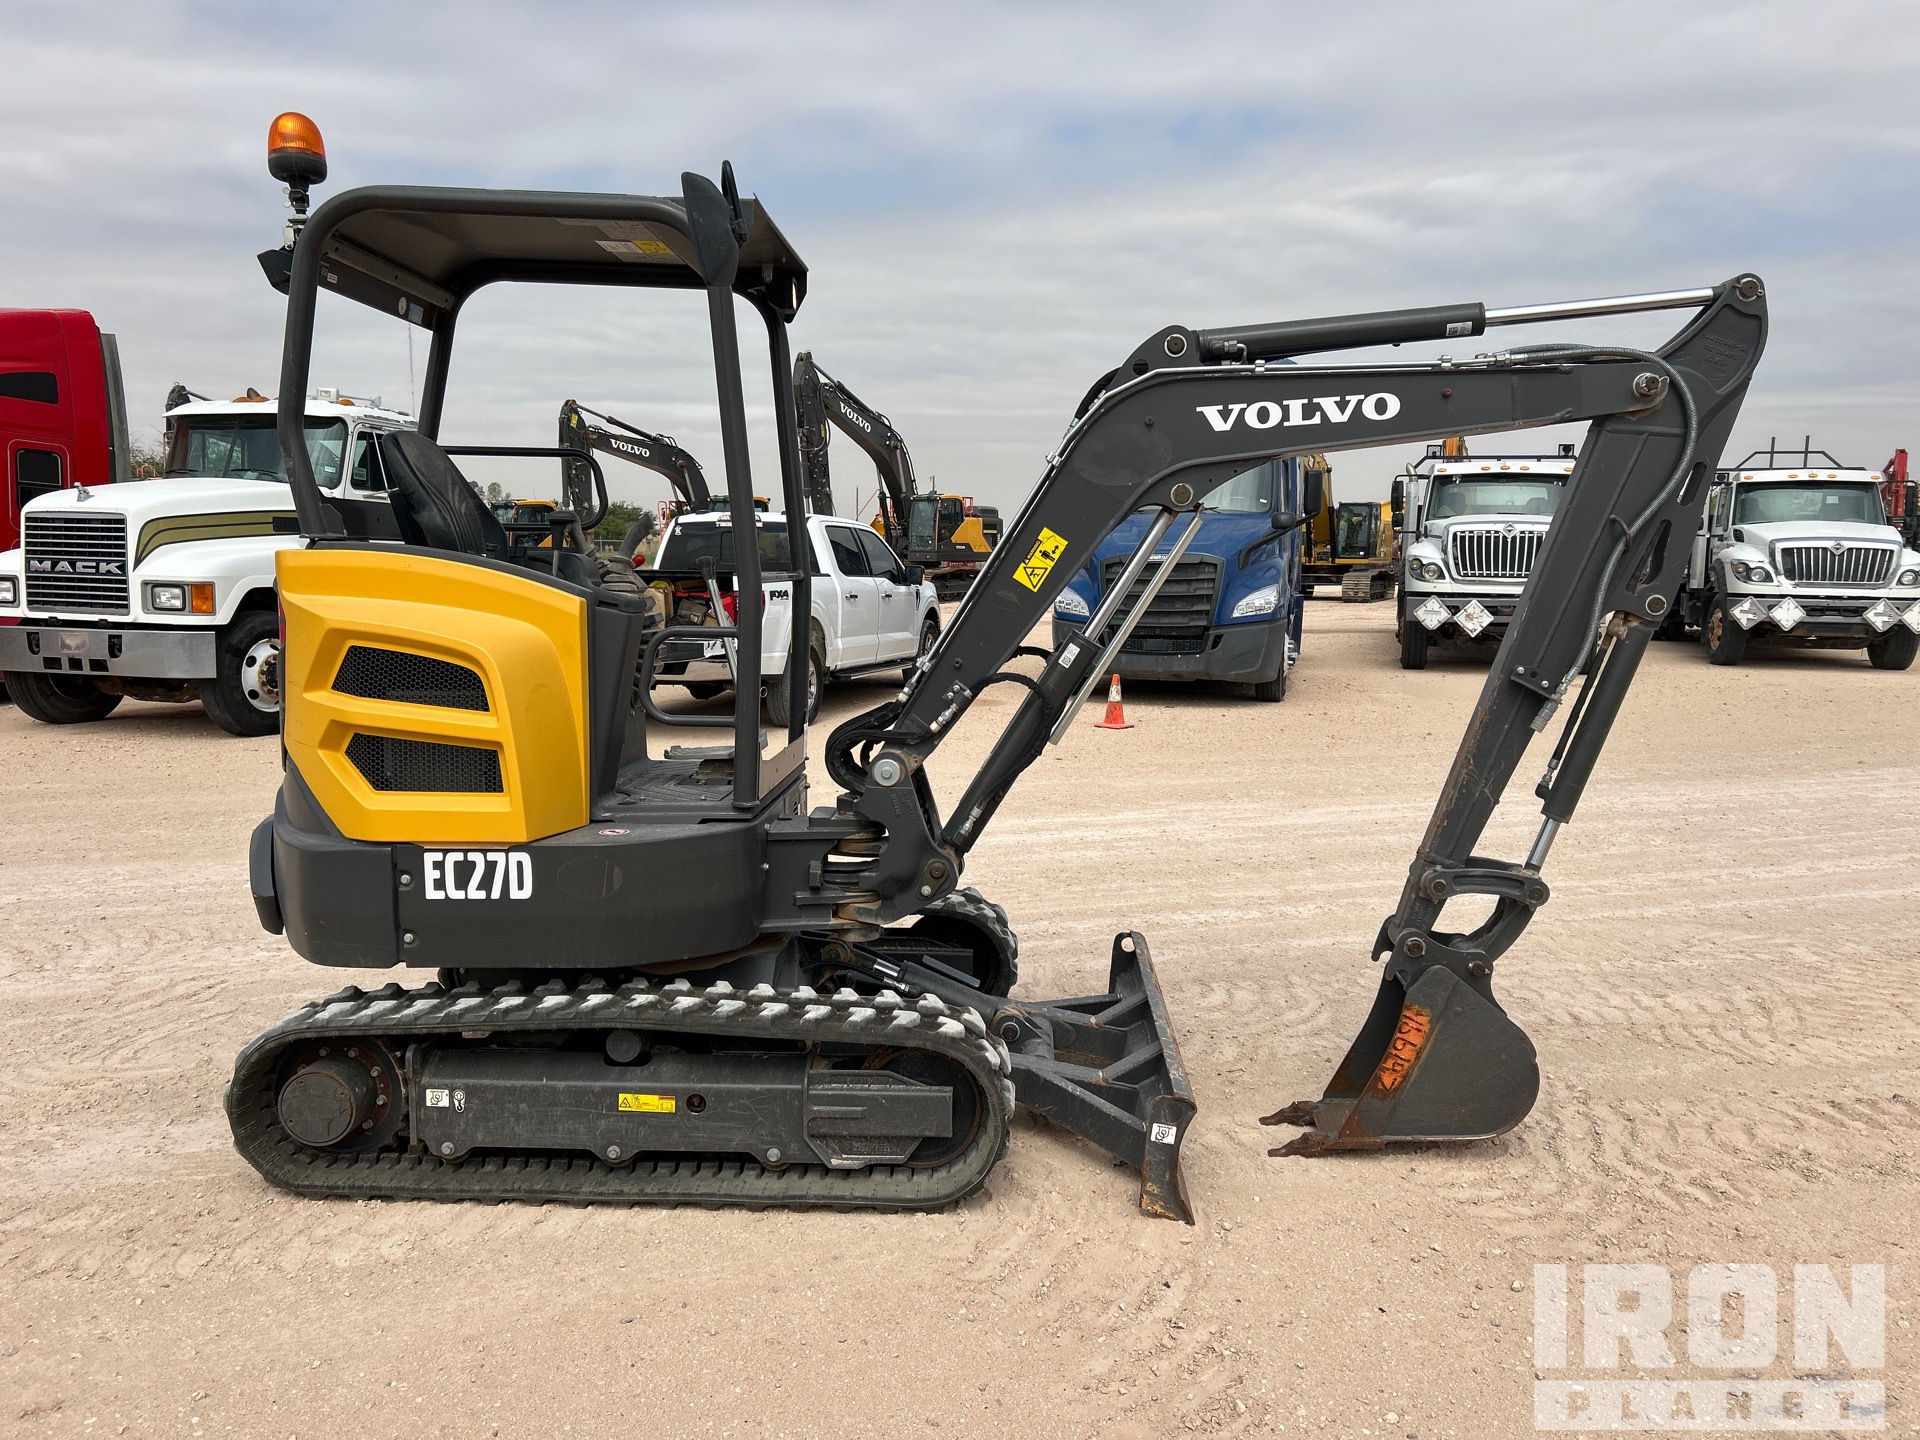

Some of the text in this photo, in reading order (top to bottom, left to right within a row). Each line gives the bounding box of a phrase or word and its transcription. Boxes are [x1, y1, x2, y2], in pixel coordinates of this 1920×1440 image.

[840, 401, 872, 433] VOLVO
[1196, 392, 1401, 432] VOLVO
[610, 438, 650, 457] VOLVO
[29, 560, 123, 574] MACK
[423, 851, 533, 900] EC27D
